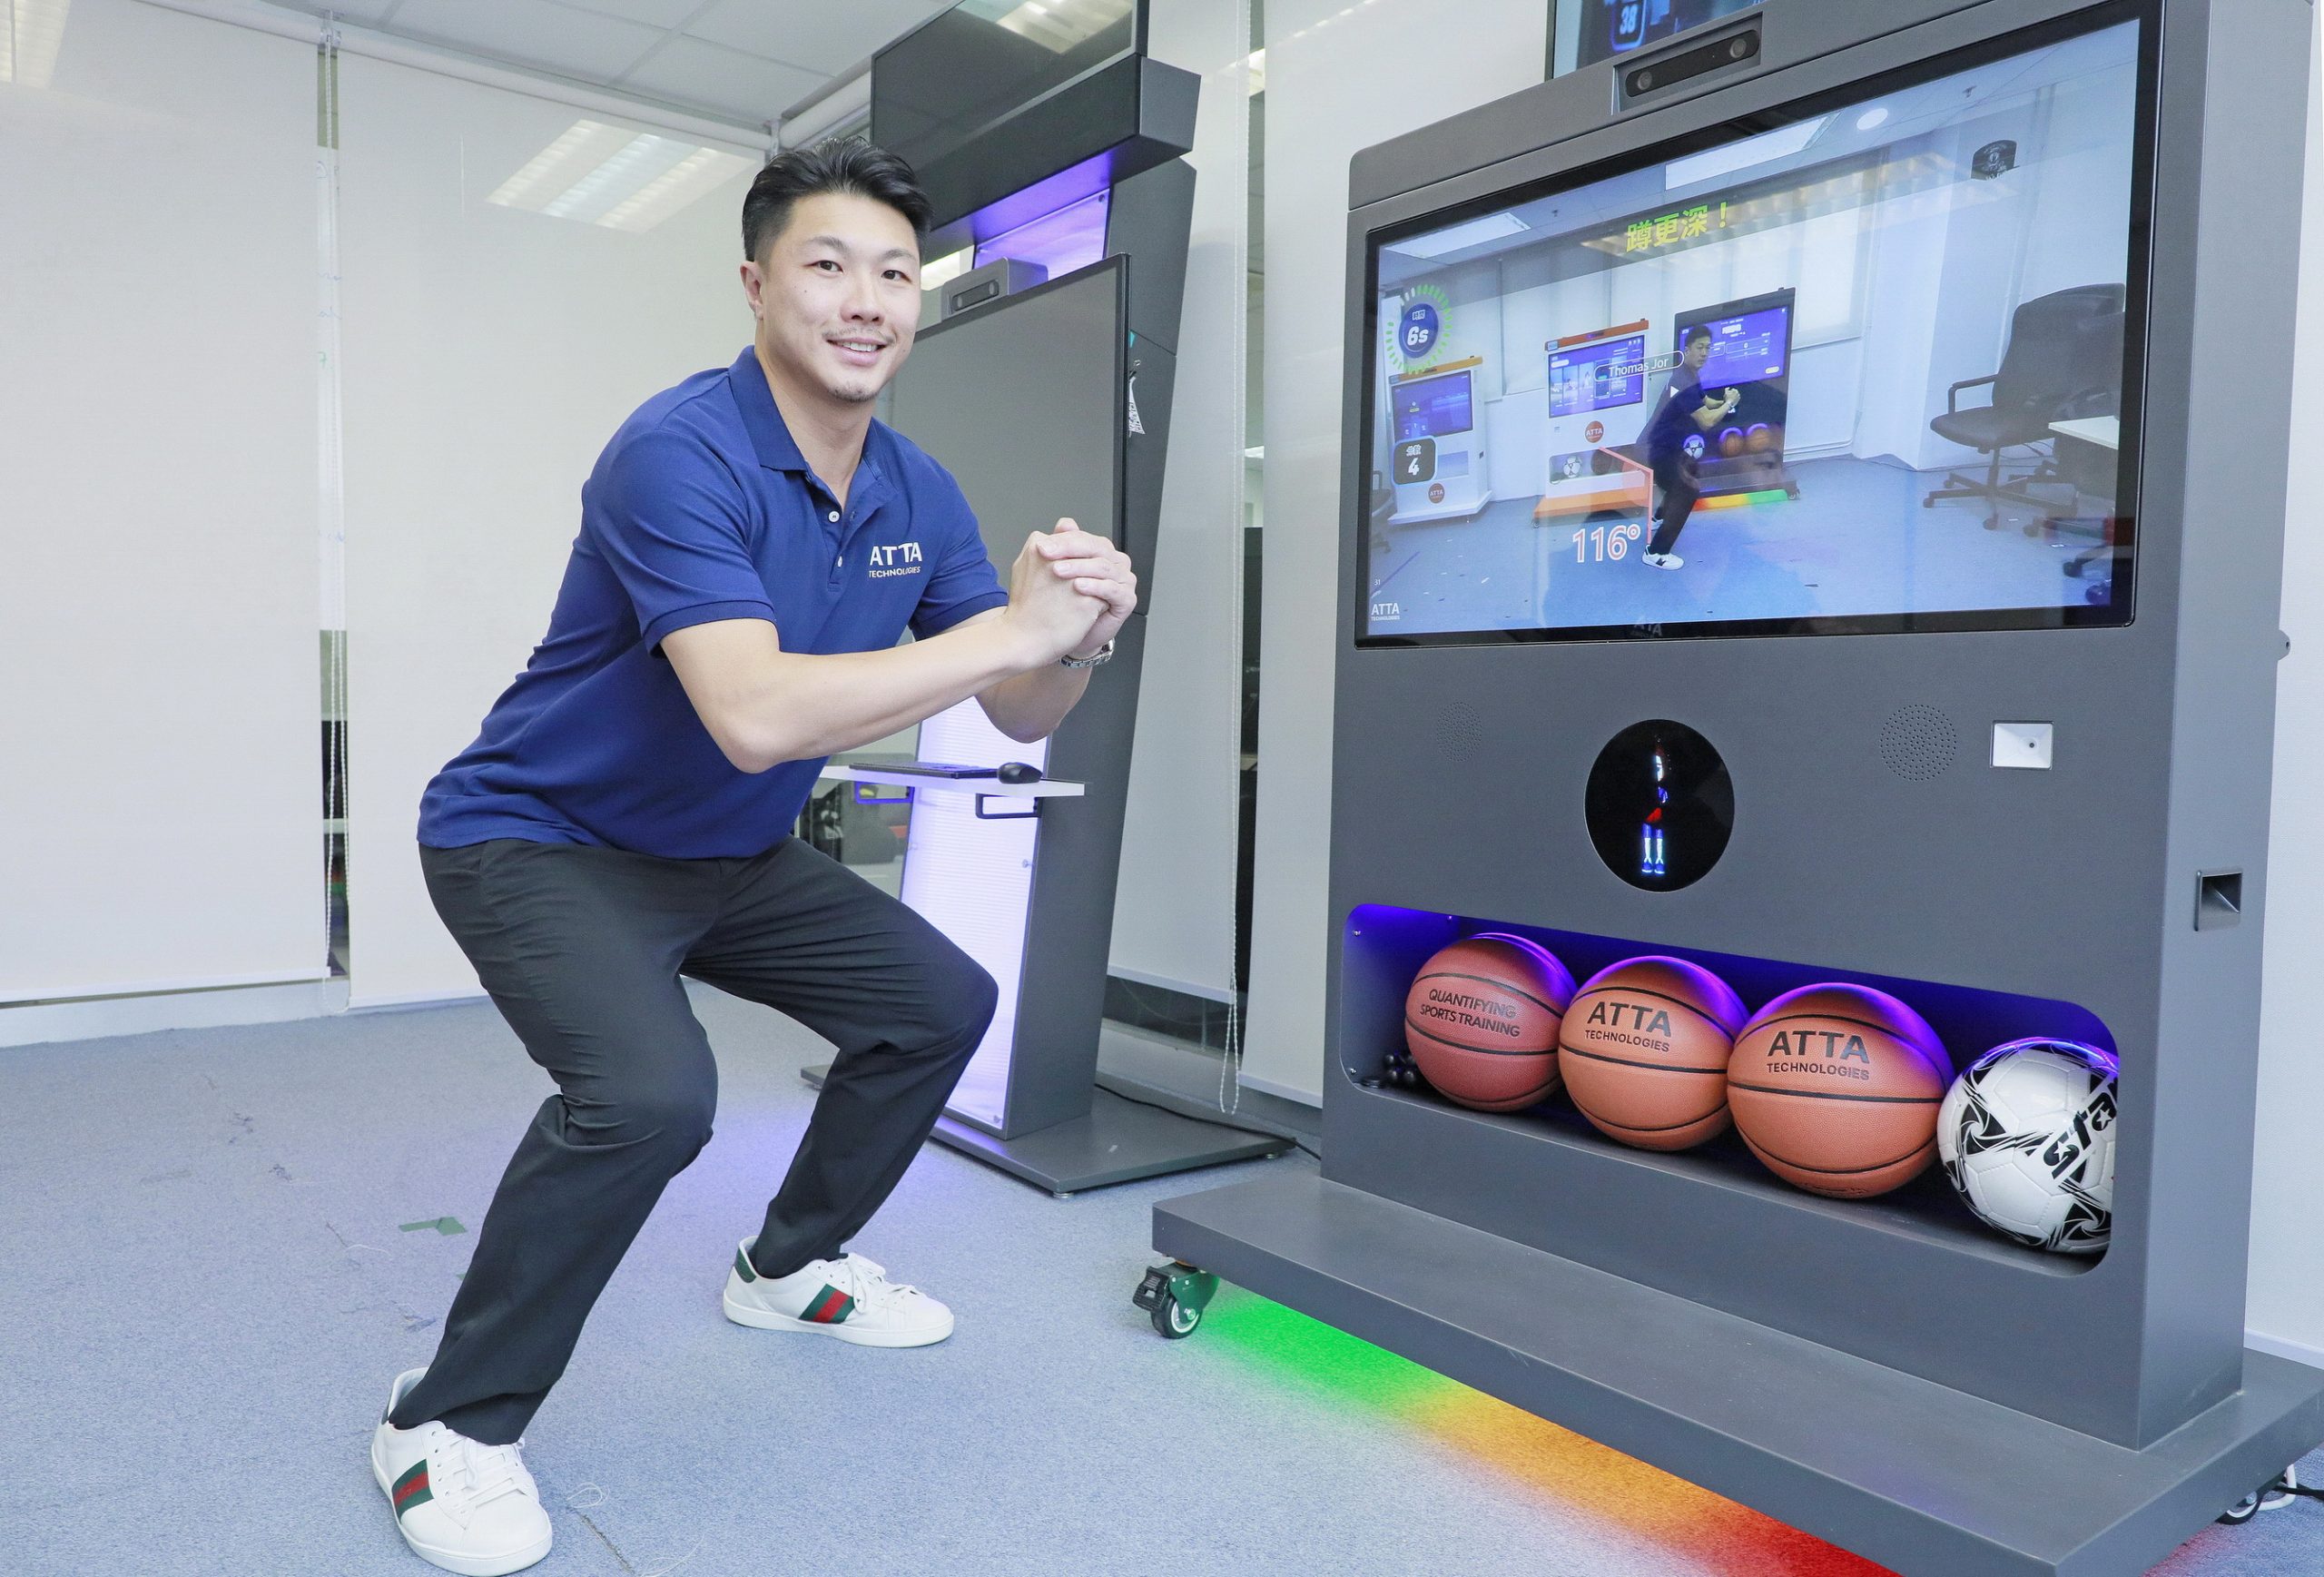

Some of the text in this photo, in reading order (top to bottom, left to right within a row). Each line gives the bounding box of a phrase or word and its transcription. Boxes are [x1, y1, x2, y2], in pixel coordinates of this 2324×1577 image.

[1619, 5, 1638, 34] 38
[1626, 202, 1727, 252] 蹲更深！
[1407, 326, 1429, 345] 6s
[1609, 357, 1669, 377] Thomas Jor
[1408, 458, 1420, 476] 4
[869, 542, 922, 566] ATTA
[1572, 523, 1641, 563] 116°
[869, 566, 921, 578] TECHNOLOGIES
[1371, 602, 1400, 616] ATTA
[1429, 989, 1516, 1019] QUANTIFYING
[1420, 1004, 1521, 1037] SPORTS TRAINING
[1587, 1001, 1671, 1038] ATTA
[1585, 1030, 1670, 1052] TECHNOLOGIES
[1767, 1030, 1870, 1064] ATTA
[1767, 1063, 1870, 1080] TECHNOLOGIES
